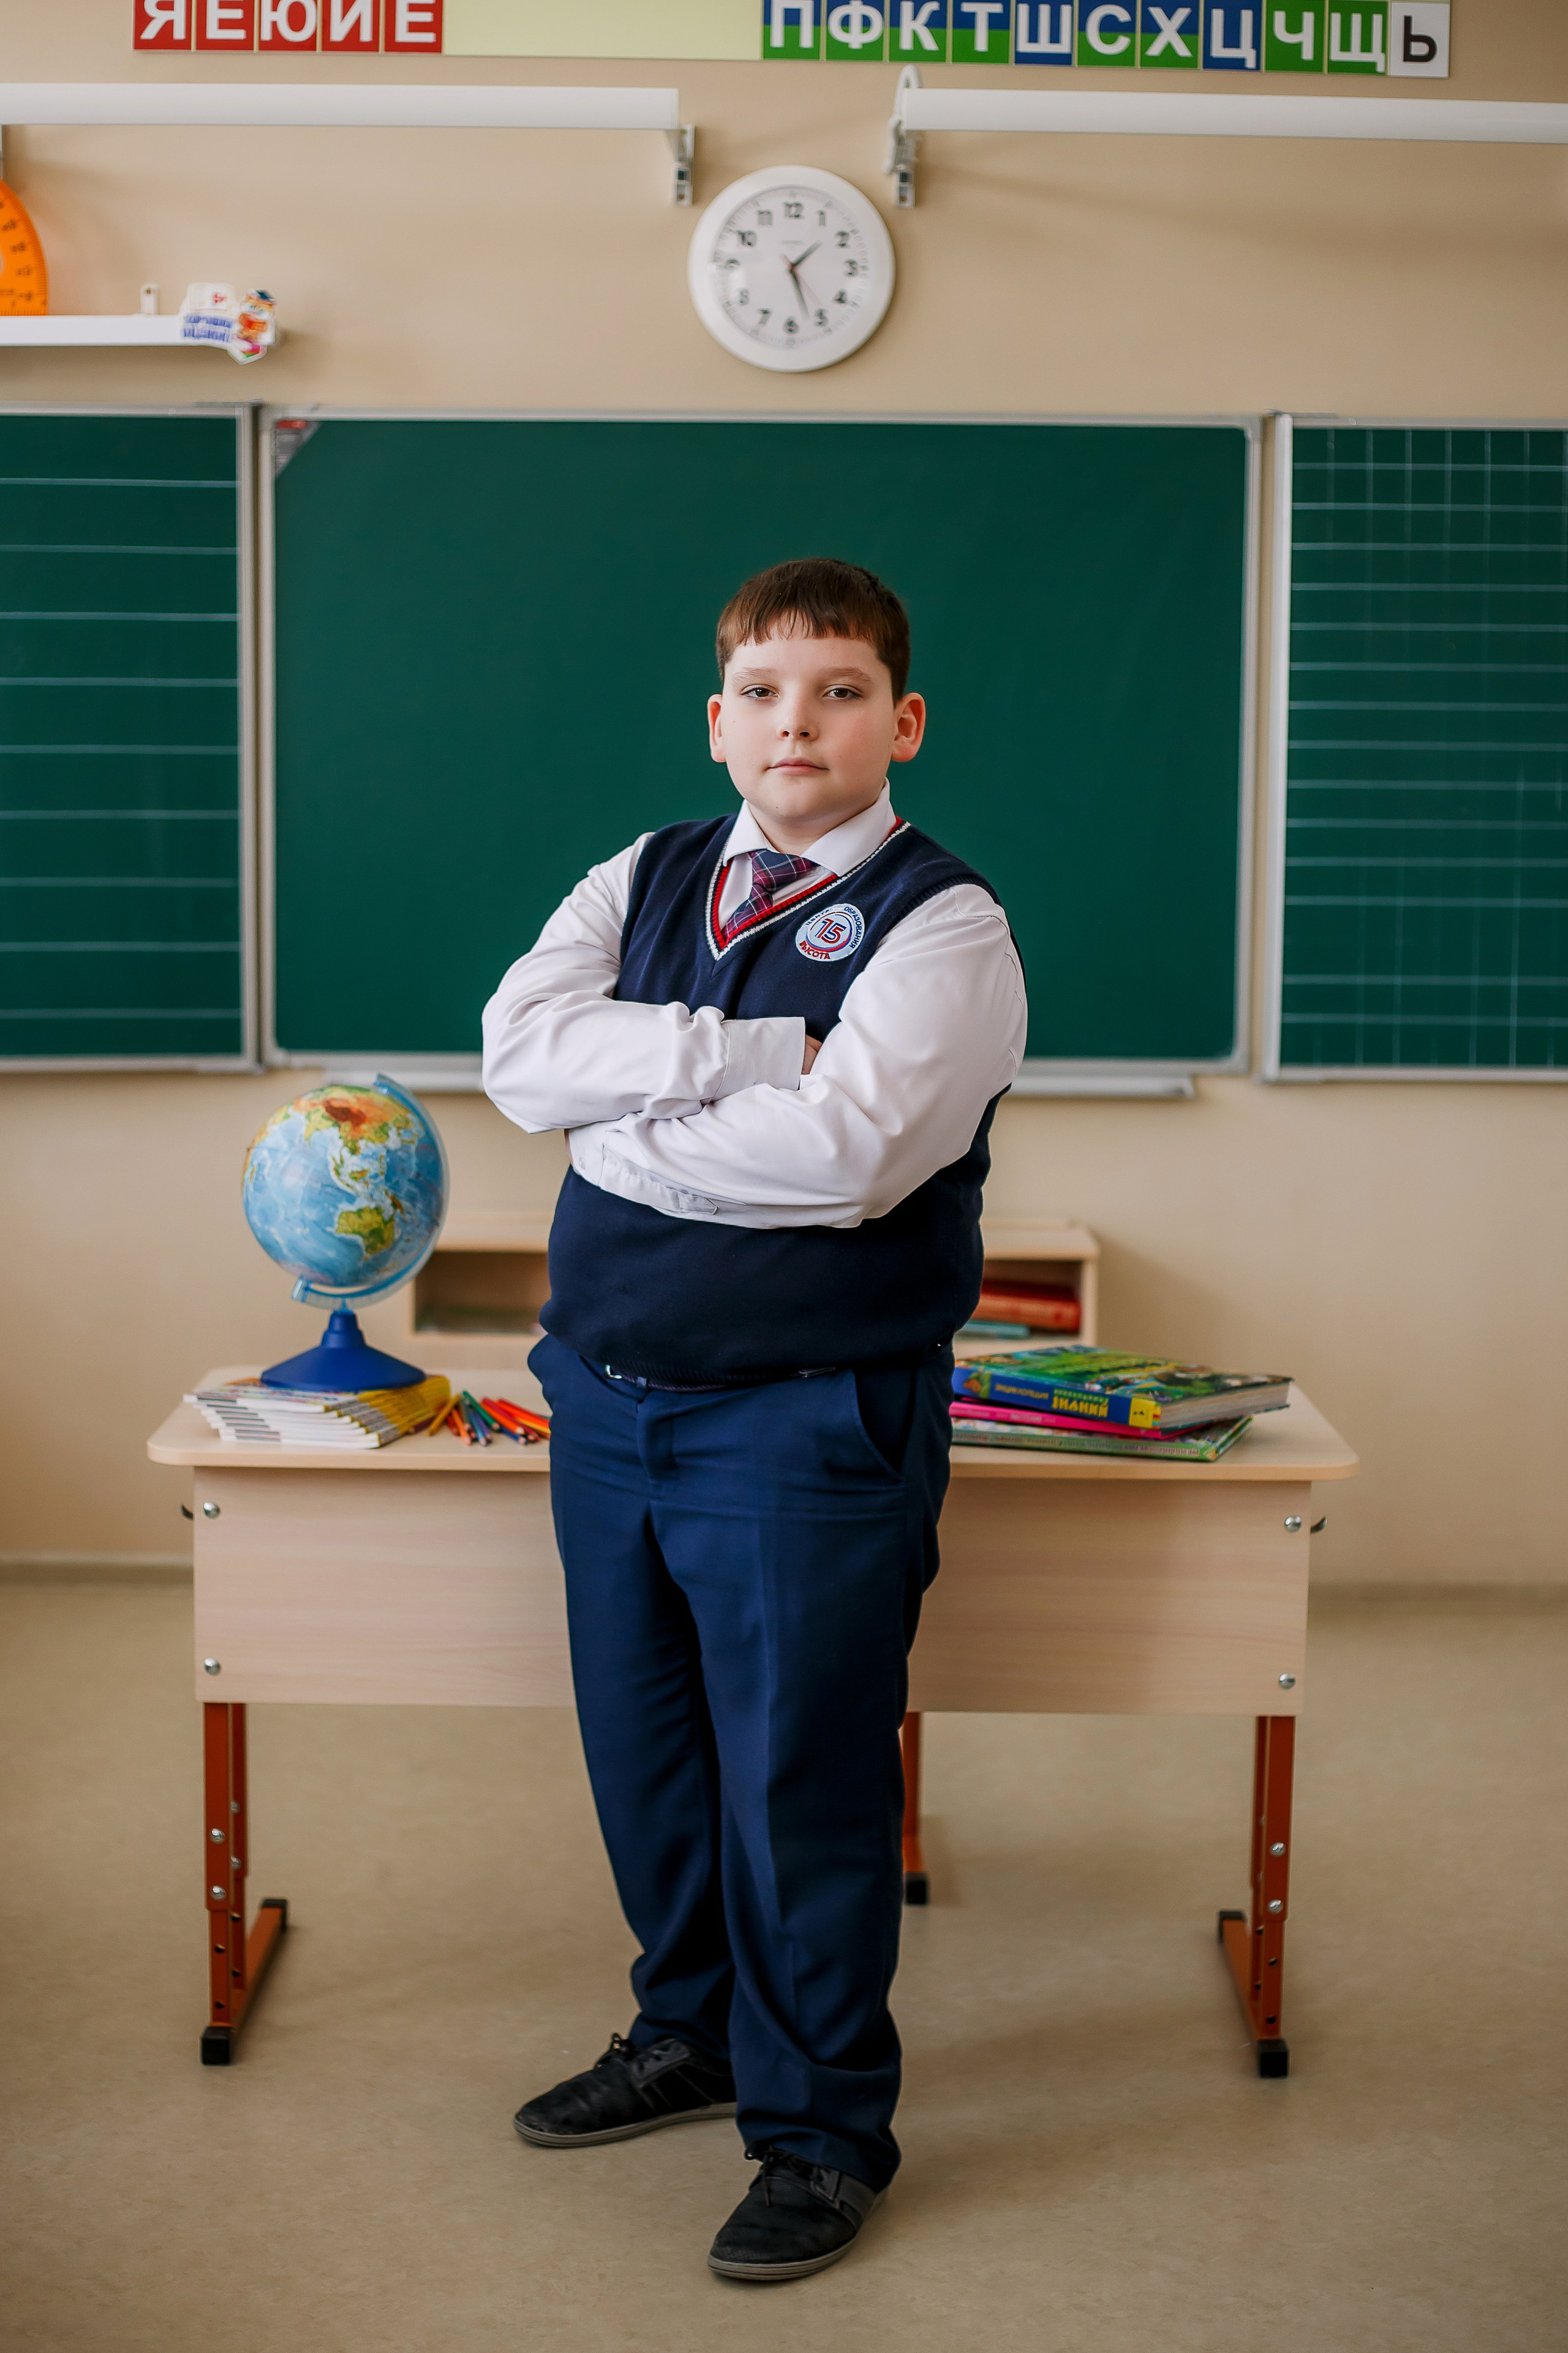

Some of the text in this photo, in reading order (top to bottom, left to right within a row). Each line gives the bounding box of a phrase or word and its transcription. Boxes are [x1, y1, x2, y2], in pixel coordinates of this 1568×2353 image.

[757, 210, 773, 226] 11
[784, 201, 804, 219] 12
[818, 210, 826, 227] 1
[737, 230, 758, 247] 10
[836, 230, 850, 247] 2
[844, 259, 858, 276] 3
[738, 289, 750, 306] 8
[834, 289, 848, 304] 4
[759, 308, 772, 326] 7
[784, 316, 799, 334] 6
[815, 309, 827, 327] 5
[815, 918, 847, 944] 15
[843, 906, 862, 949] ОБРАЗОВАНИЯ
[799, 940, 831, 960] ВЫСОТА
[1052, 1396, 1109, 1418] ЗНАНИЙ
